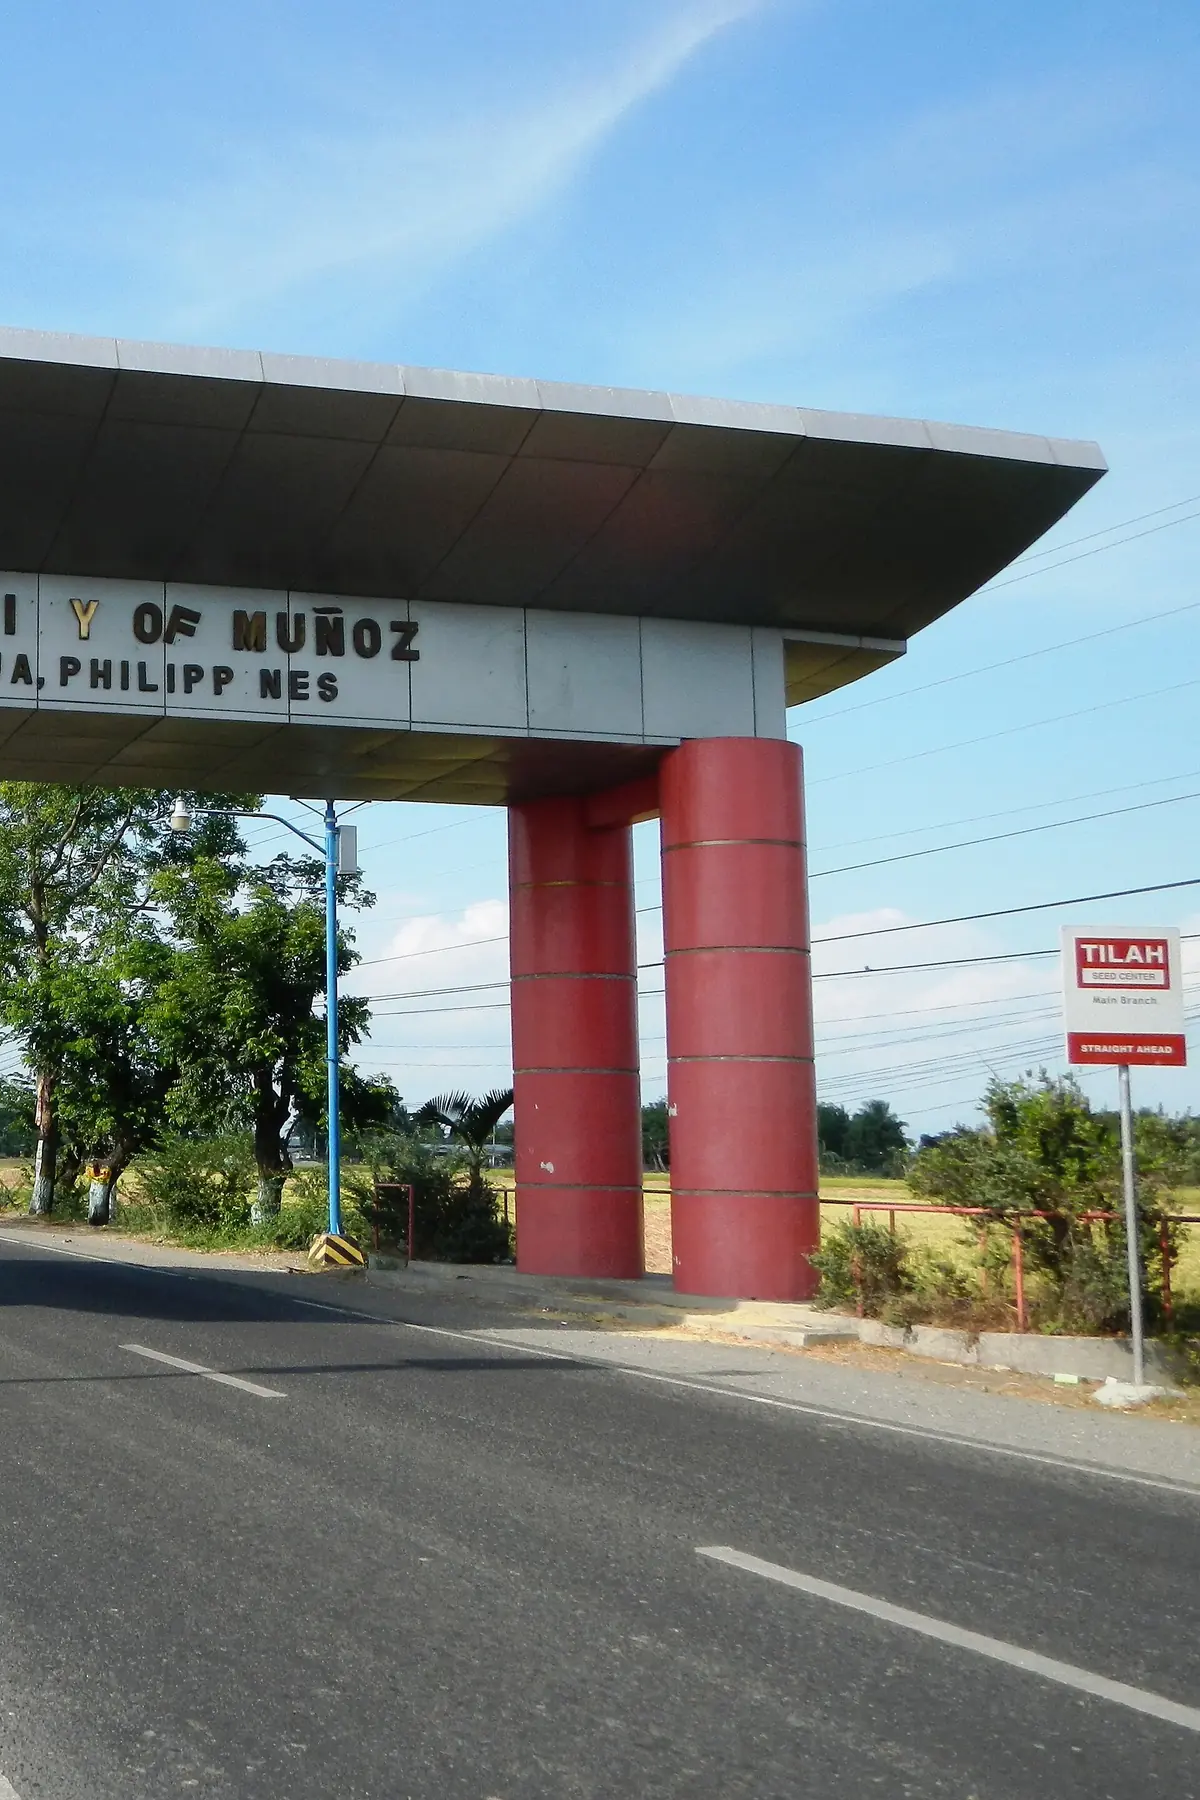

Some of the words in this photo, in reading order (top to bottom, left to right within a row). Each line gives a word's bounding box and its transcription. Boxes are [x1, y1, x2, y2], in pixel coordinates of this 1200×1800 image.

[133, 602, 202, 645] OF
[232, 606, 420, 662] MUÑOZ
[59, 655, 339, 703] PHILIPPNES
[1080, 944, 1164, 964] TILAH
[1092, 972, 1116, 980] SEED
[1119, 972, 1156, 981] CENTER
[1093, 996, 1117, 1004] Main
[1121, 996, 1157, 1005] Branch
[1080, 1044, 1133, 1053] STRAIGHT
[1137, 1045, 1173, 1054] AHEAD
